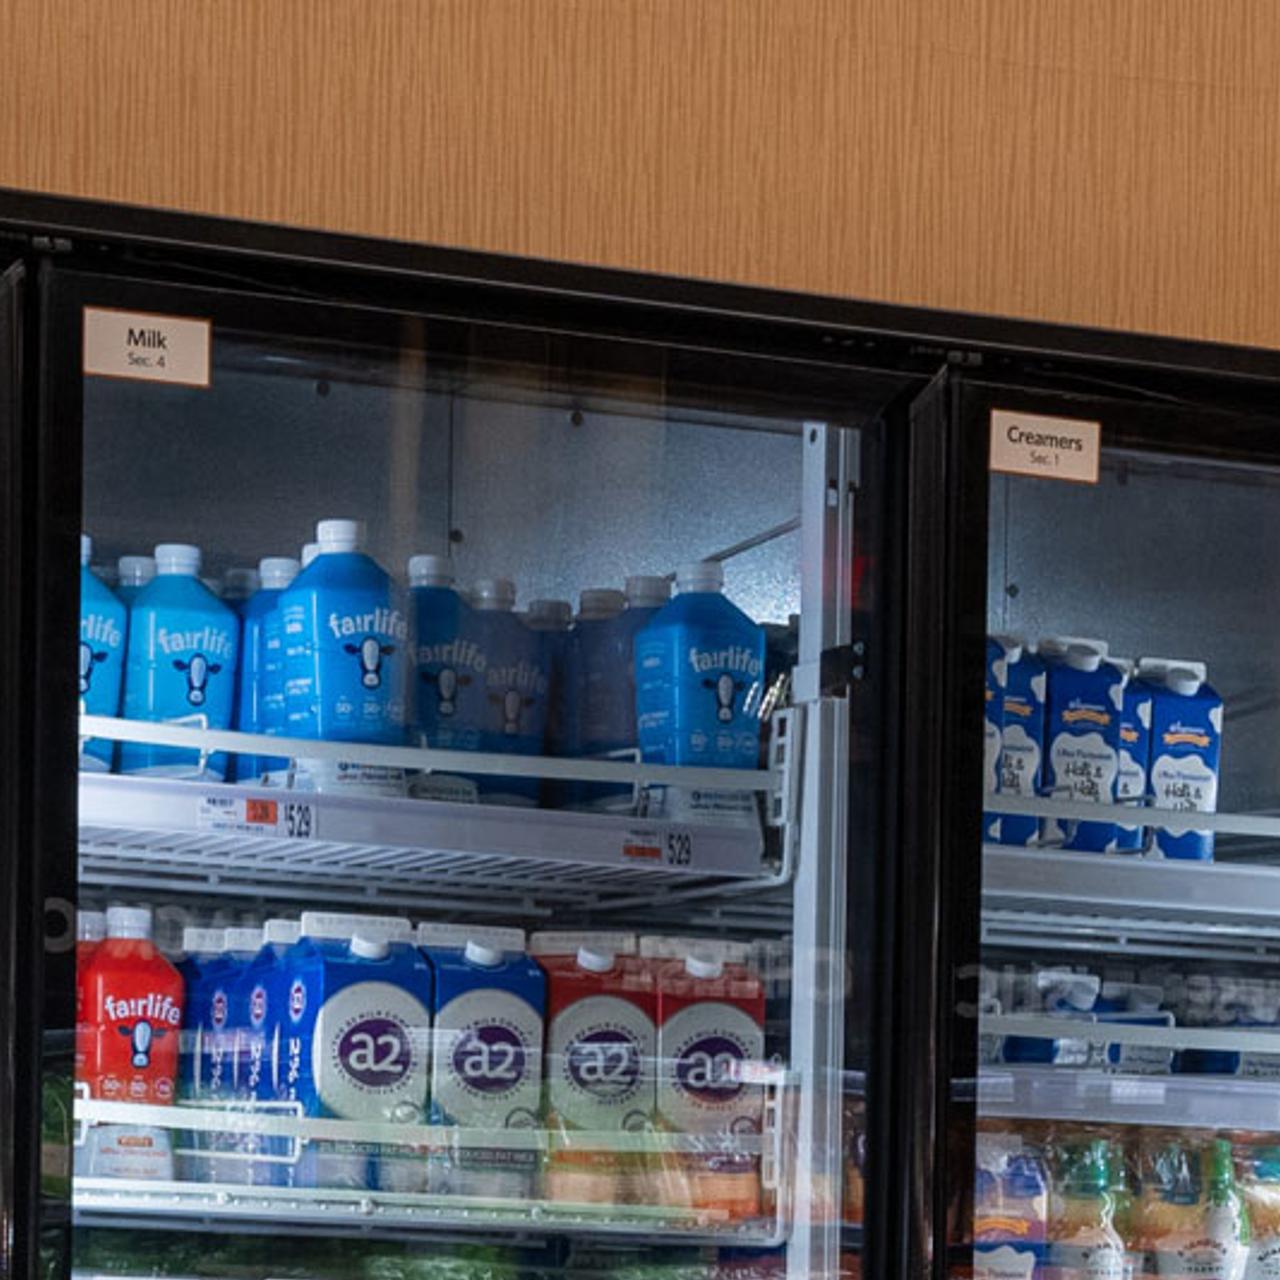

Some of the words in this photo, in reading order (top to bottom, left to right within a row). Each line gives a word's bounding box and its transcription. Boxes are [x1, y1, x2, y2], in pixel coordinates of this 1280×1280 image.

[127, 328, 168, 350] Milk
[128, 352, 153, 368] Sec.
[156, 355, 165, 368] 4
[1007, 426, 1083, 451] Creamers
[1029, 452, 1051, 466] Sec.
[80, 614, 120, 649] rlife
[328, 607, 409, 642] fairlife
[158, 625, 233, 658] fairlife
[688, 645, 762, 676] fairlife
[104, 994, 180, 1024] fairlife
[348, 1031, 404, 1073] a2
[463, 1039, 517, 1080] a2
[578, 1047, 631, 1082] a2
